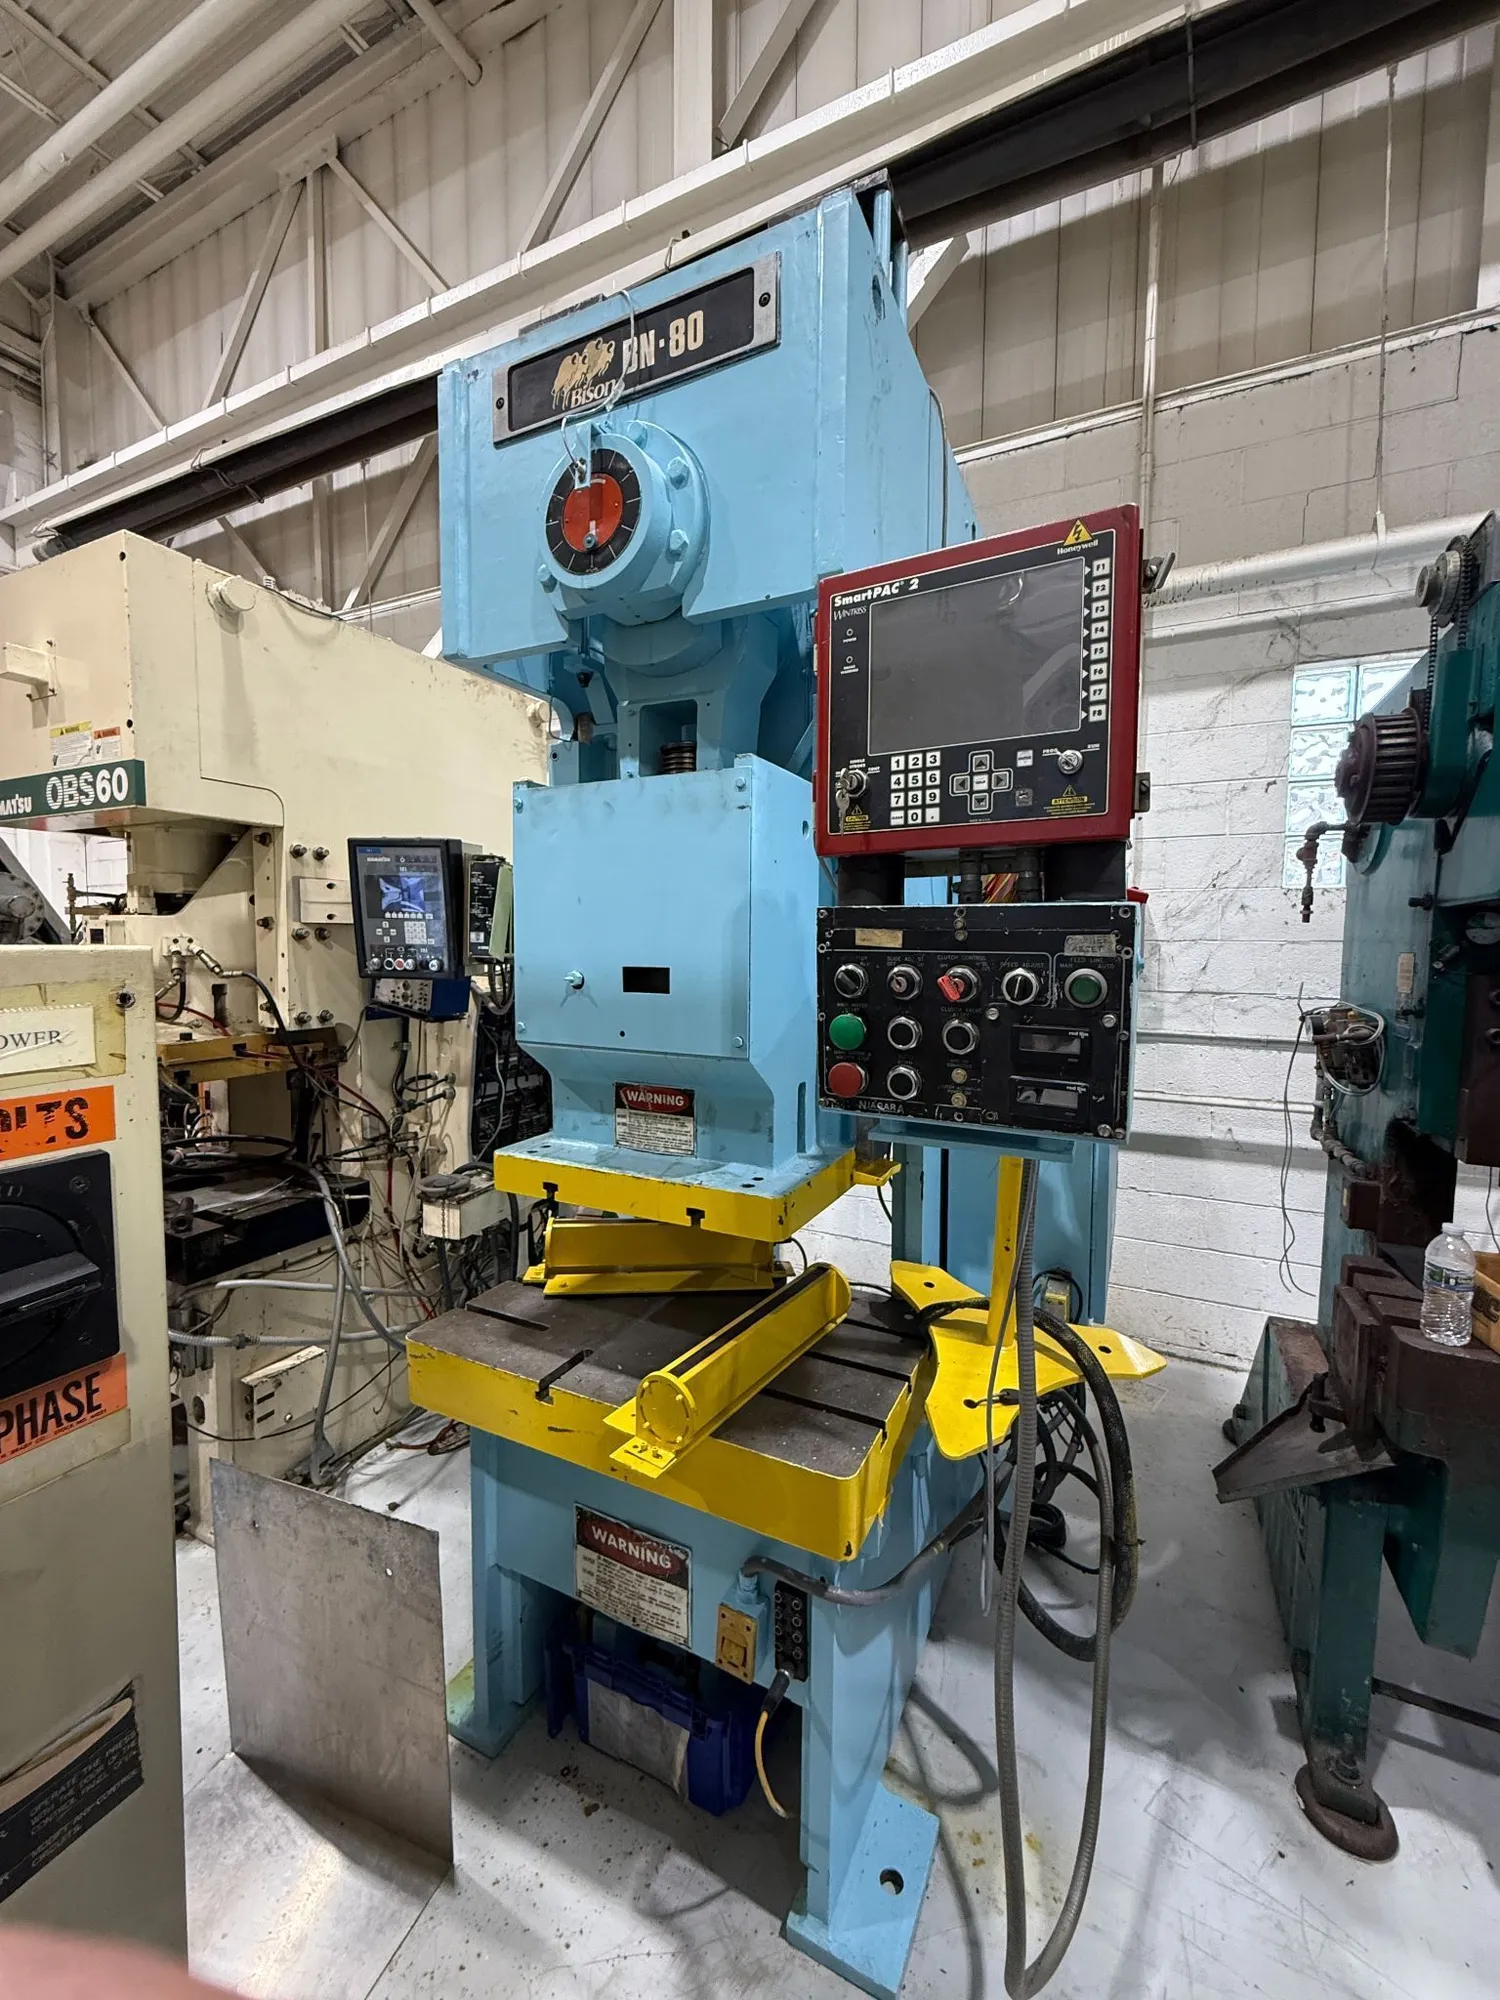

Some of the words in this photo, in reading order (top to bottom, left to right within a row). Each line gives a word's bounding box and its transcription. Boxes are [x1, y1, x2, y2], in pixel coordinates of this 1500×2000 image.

[1057, 539, 1099, 555] Honeywell
[1095, 563, 1105, 571] F1
[908, 578, 919, 590] 2
[1095, 584, 1106, 592] F2
[1095, 605, 1105, 613] F3
[1094, 626, 1105, 634] F4
[1094, 647, 1104, 655] F5
[1093, 668, 1103, 676] F6
[1093, 688, 1103, 696] F7
[1092, 709, 1102, 717] F8
[894, 758, 900, 768] 1
[911, 756, 919, 766] 2
[929, 754, 937, 764] 3
[893, 776, 901, 787] 4
[911, 775, 919, 785] 5
[929, 773, 937, 783] 6
[893, 795, 901, 805] 7
[911, 793, 918, 803] 8
[929, 791, 937, 801] 9
[911, 812, 918, 821] 0
[626, 1090, 684, 1107] WARNING
[592, 1525, 672, 1569] WARNING
